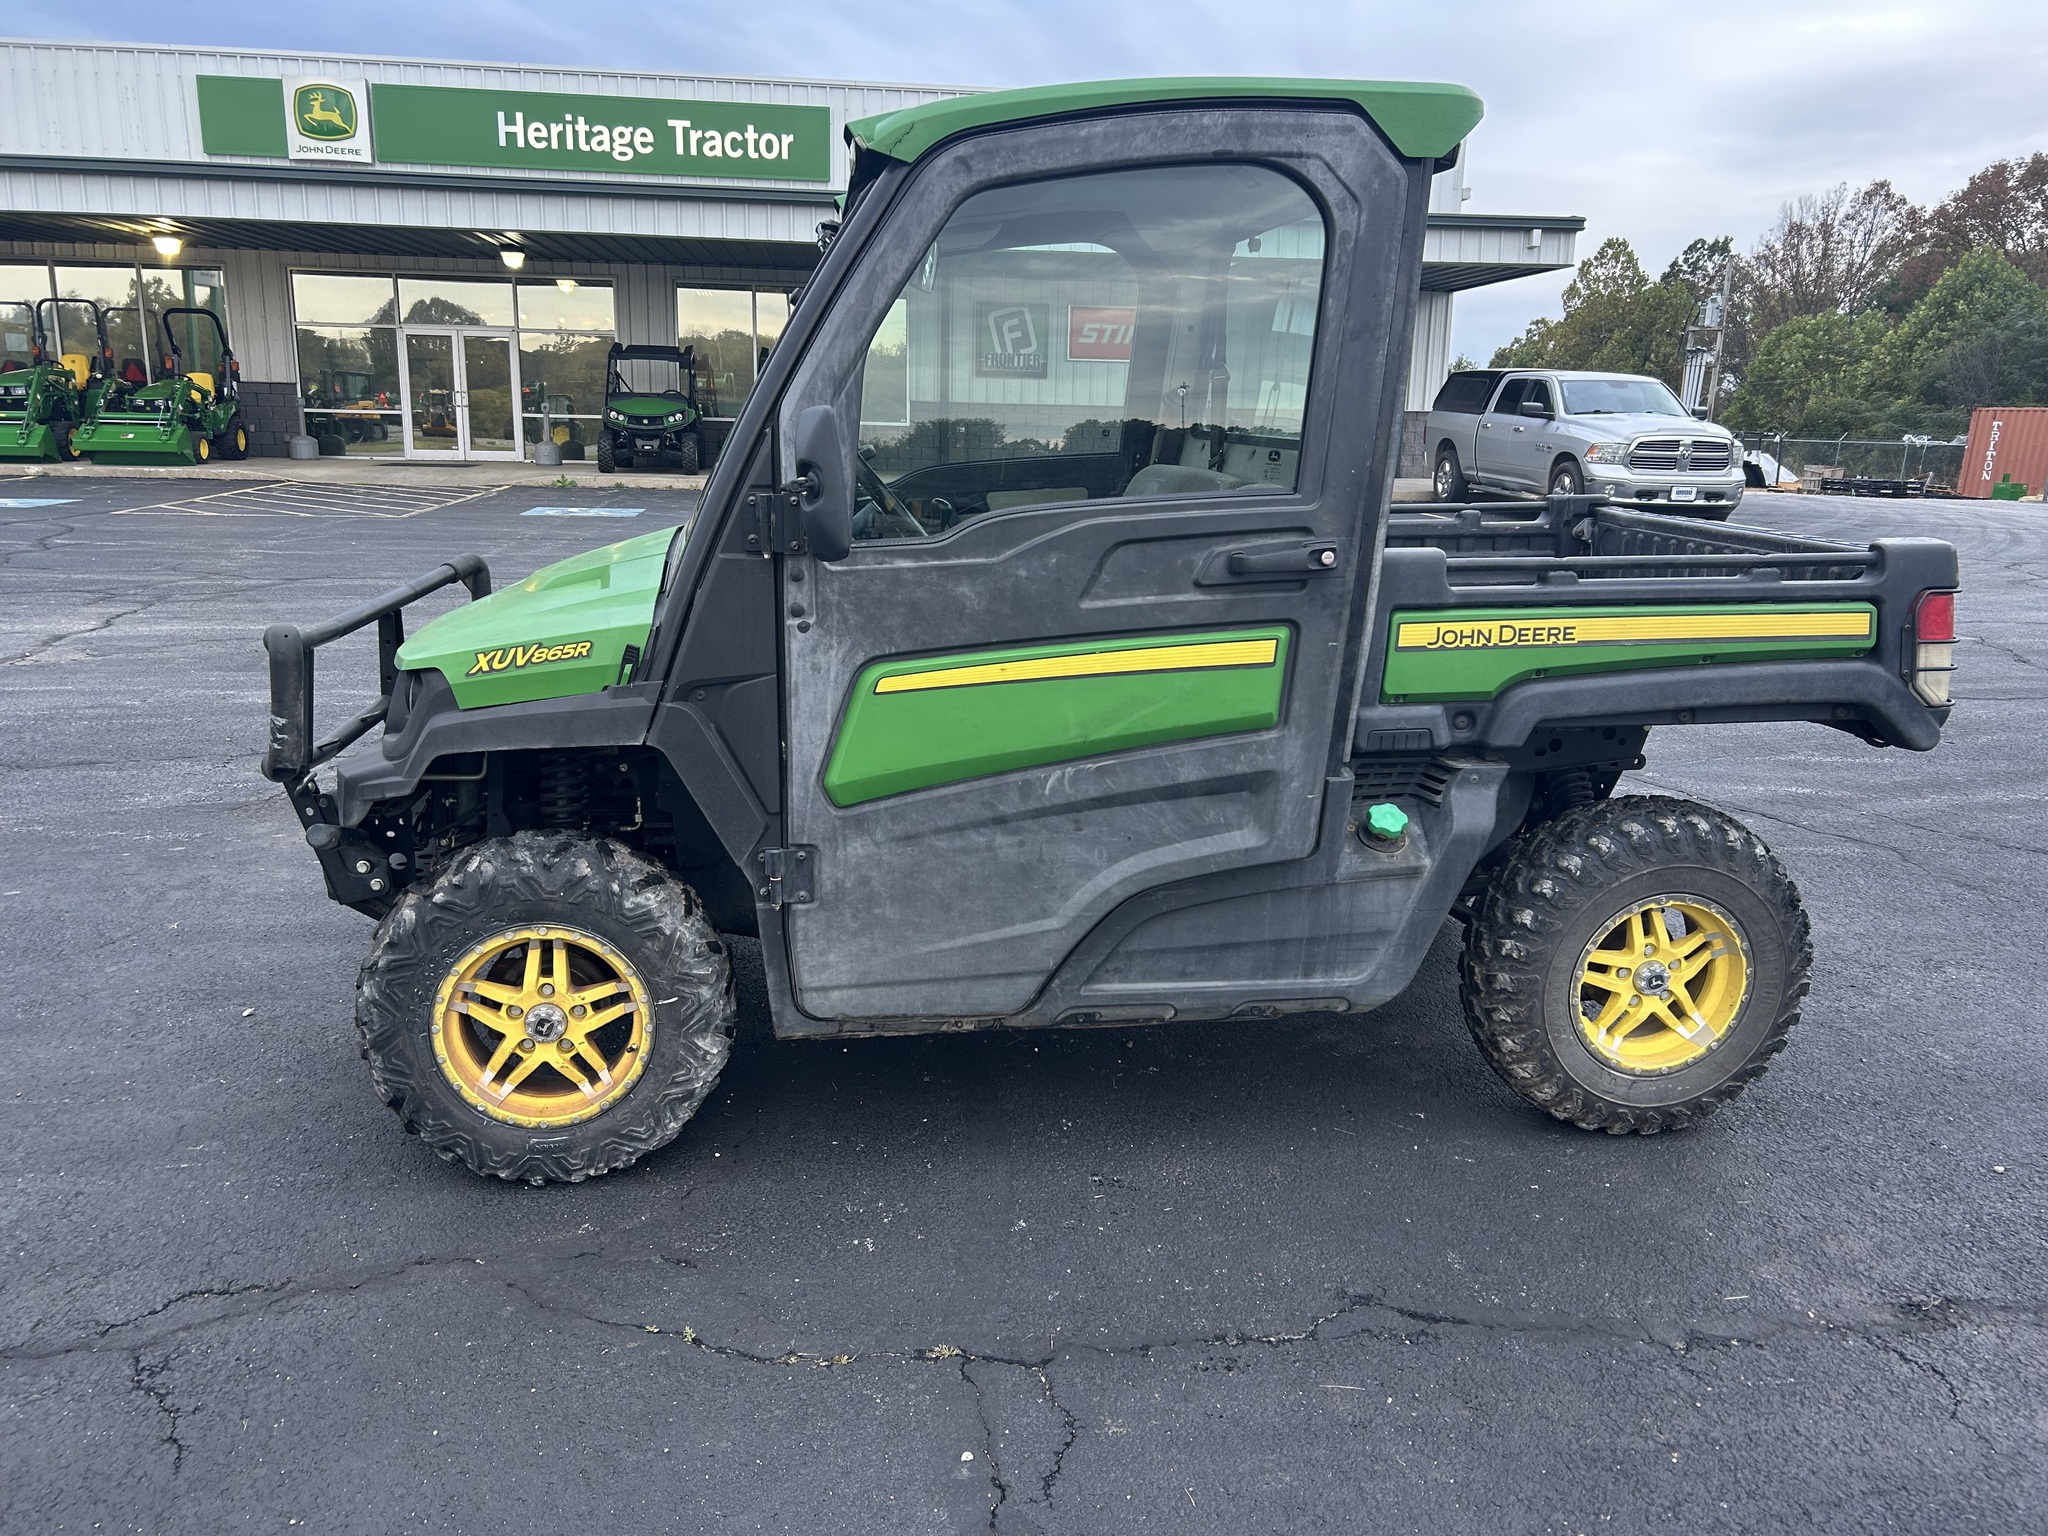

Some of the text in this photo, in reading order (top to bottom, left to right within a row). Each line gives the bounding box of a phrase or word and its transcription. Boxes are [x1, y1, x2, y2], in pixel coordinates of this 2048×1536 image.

[497, 111, 794, 161] Heritage Tractor
[296, 145, 362, 156] JOHN DEERE
[985, 352, 1041, 369] FRONTIER
[1981, 421, 2003, 480] TRITON
[1427, 624, 1577, 646] JOHN DEERE
[466, 641, 592, 676] XUV865R
